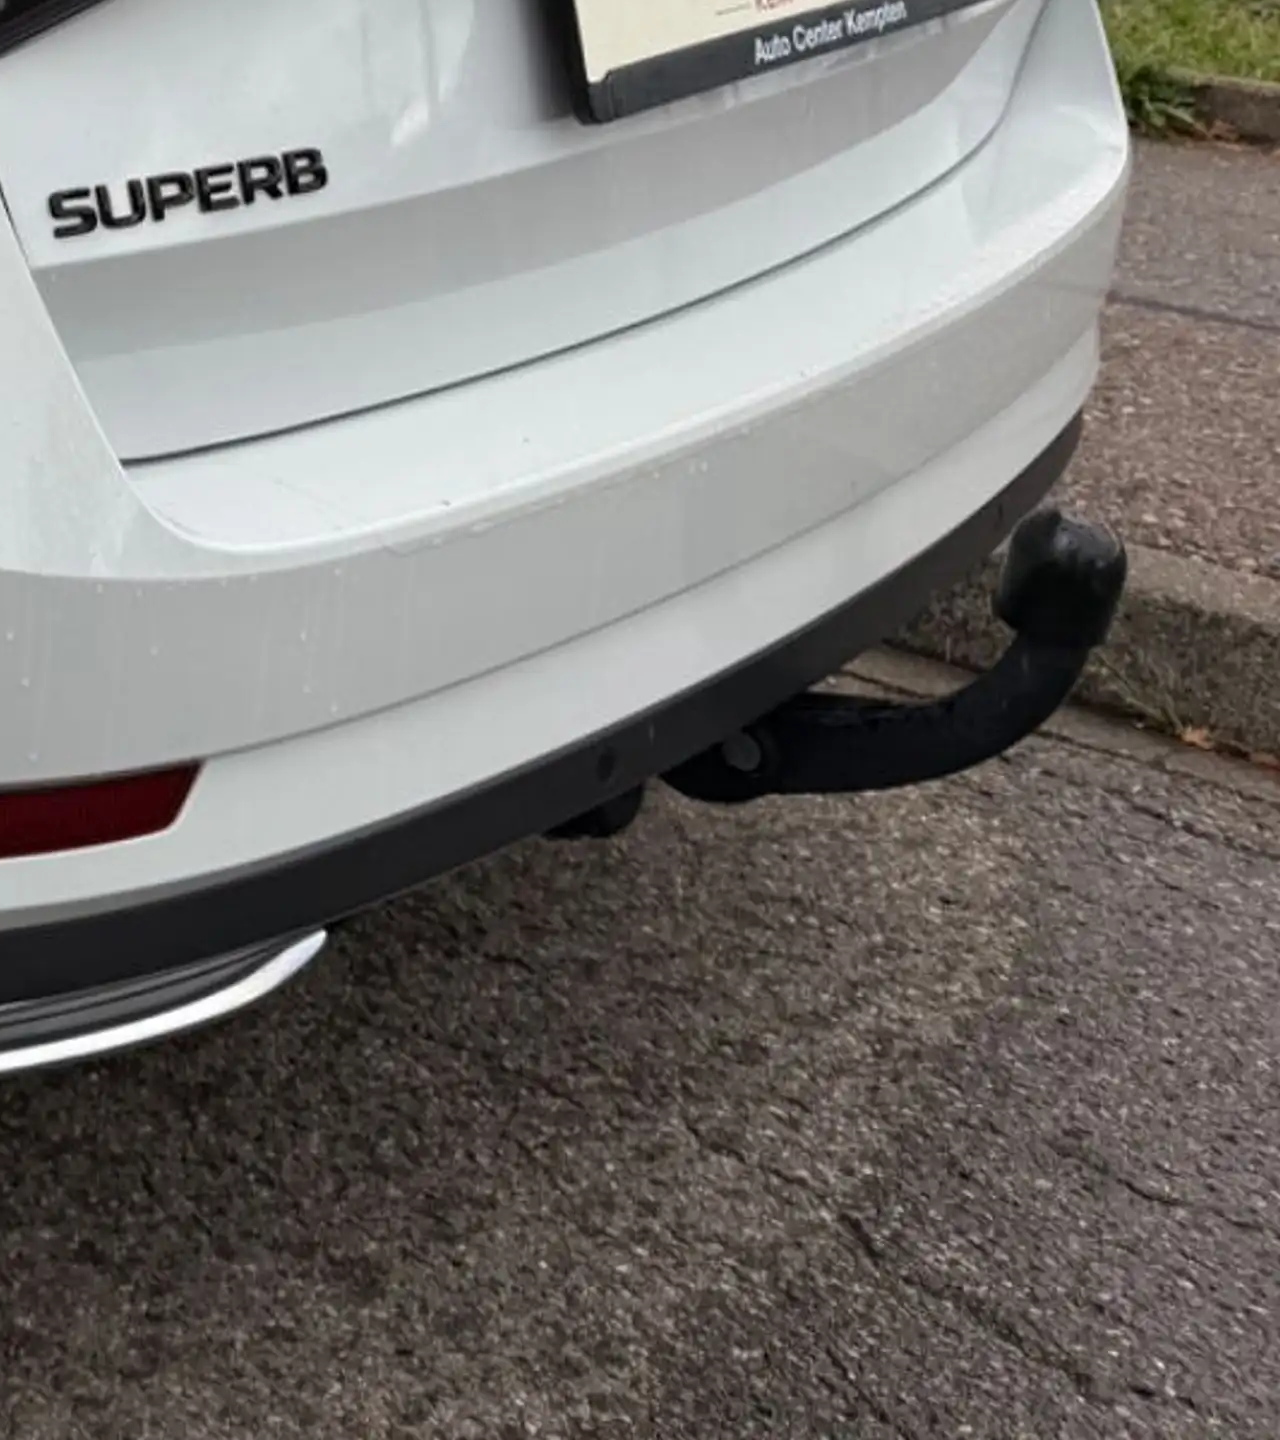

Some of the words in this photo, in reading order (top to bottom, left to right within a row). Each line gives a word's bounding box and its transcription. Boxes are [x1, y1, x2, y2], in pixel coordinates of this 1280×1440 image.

[754, 35, 791, 65] Auto
[792, 19, 843, 51] Center
[843, 0, 908, 36] Kempten
[47, 147, 329, 239] SUPERB
